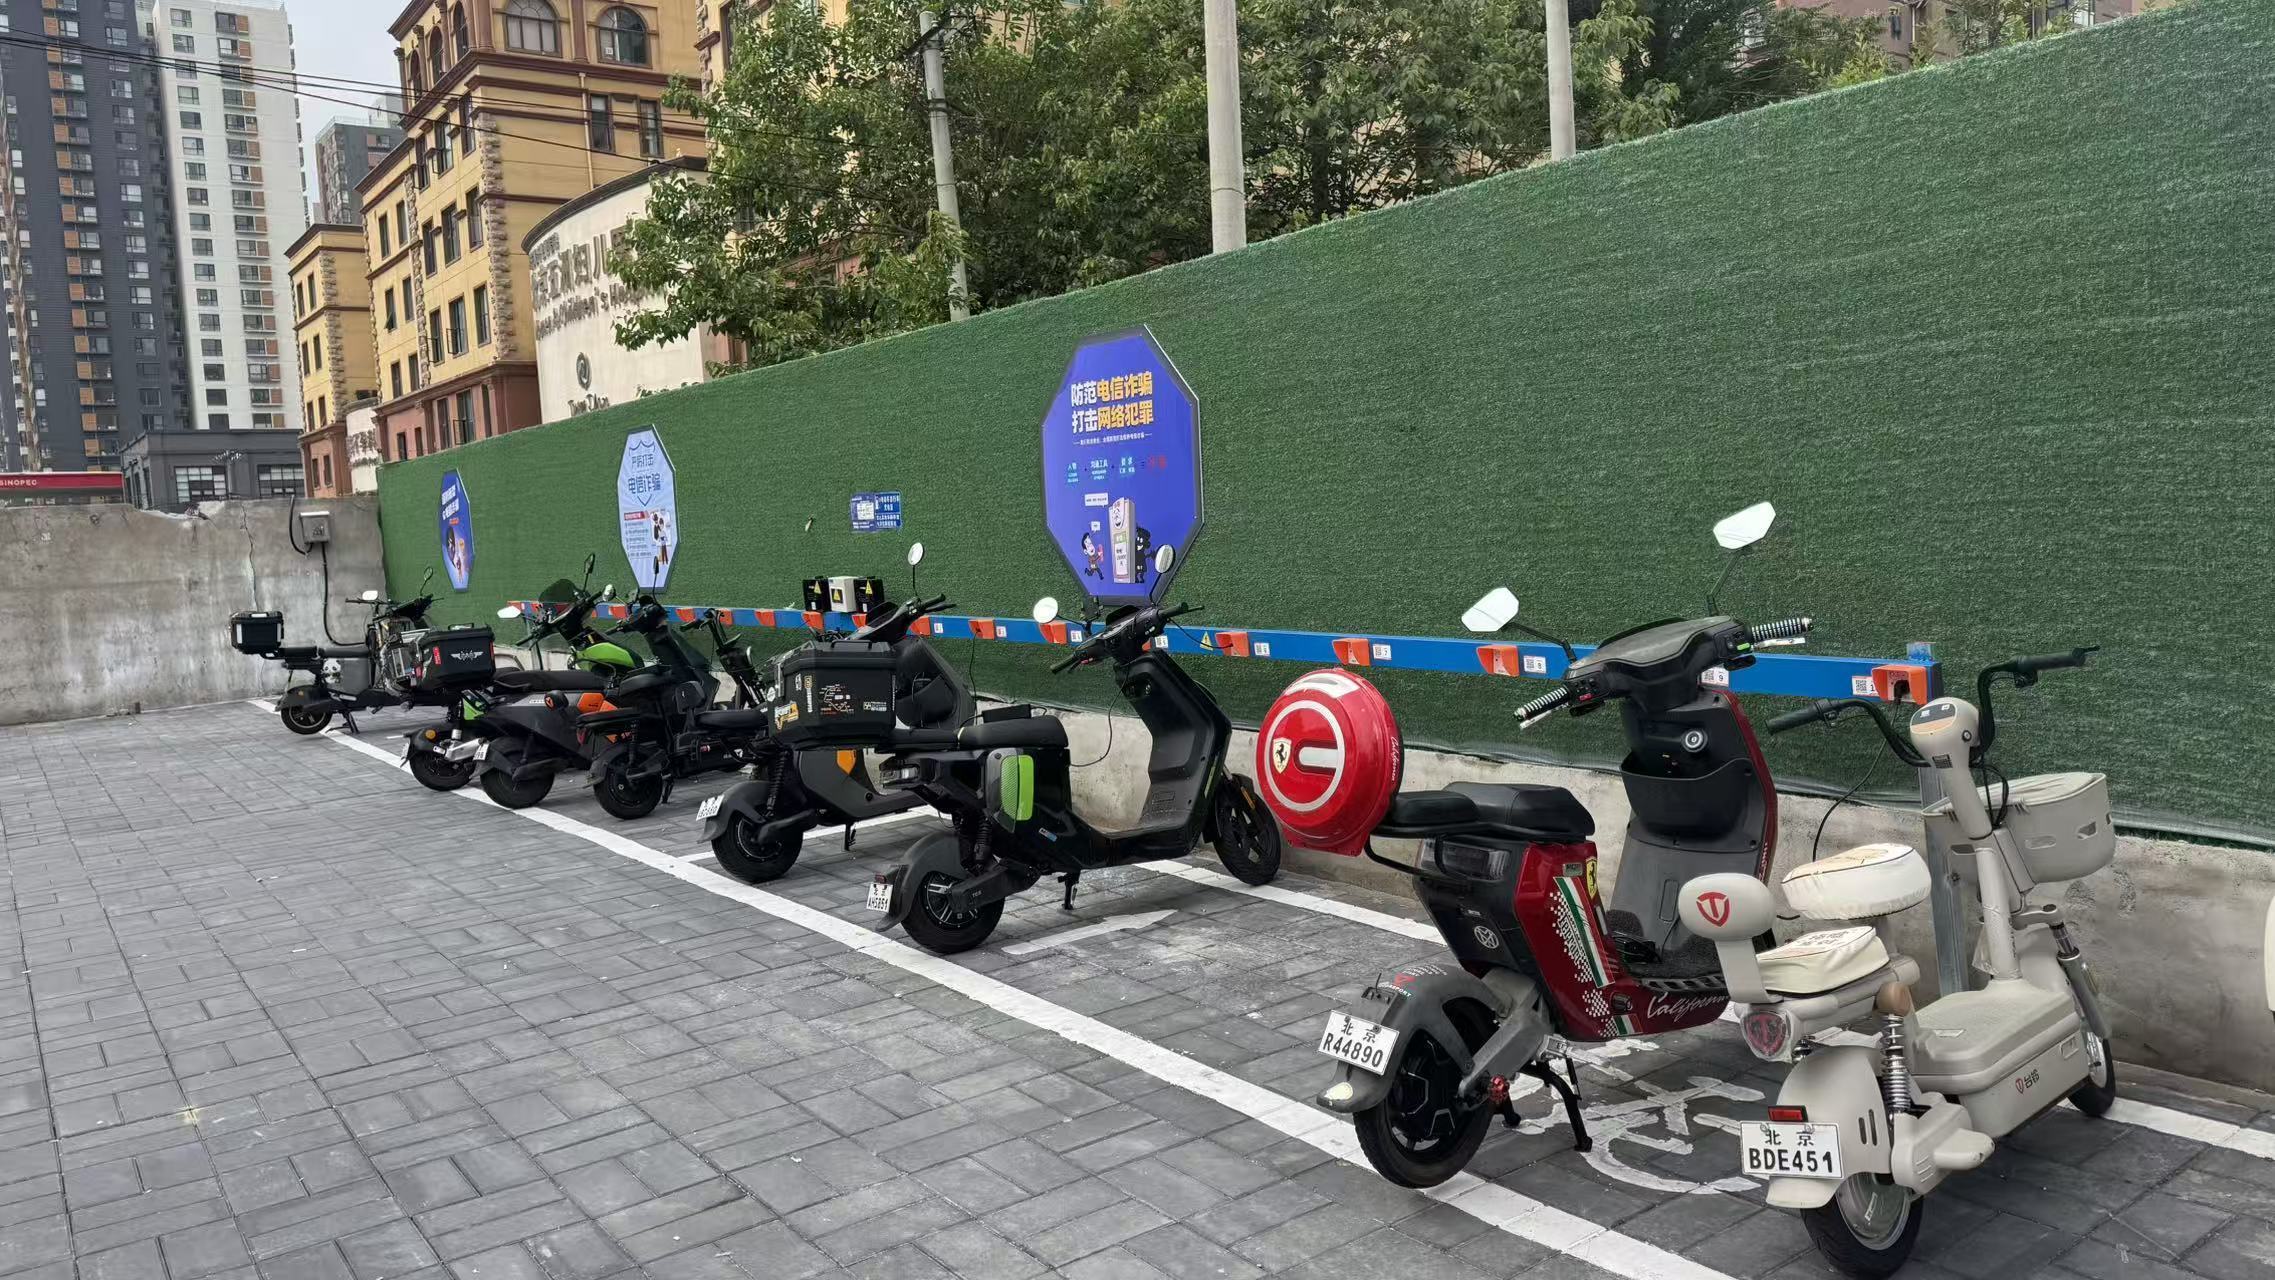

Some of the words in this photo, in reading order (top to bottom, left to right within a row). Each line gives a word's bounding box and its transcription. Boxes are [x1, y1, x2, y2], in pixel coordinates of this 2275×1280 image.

[1071, 371, 1152, 406] 防范电信诈骗
[1072, 399, 1154, 433] 打击网络犯罪
[628, 473, 661, 494] 电信诈骗
[1341, 1019, 1381, 1043] 北京
[1323, 1032, 1384, 1067] R44890
[1764, 1128, 1815, 1147] 北京
[1749, 1148, 1833, 1173] BDE451
